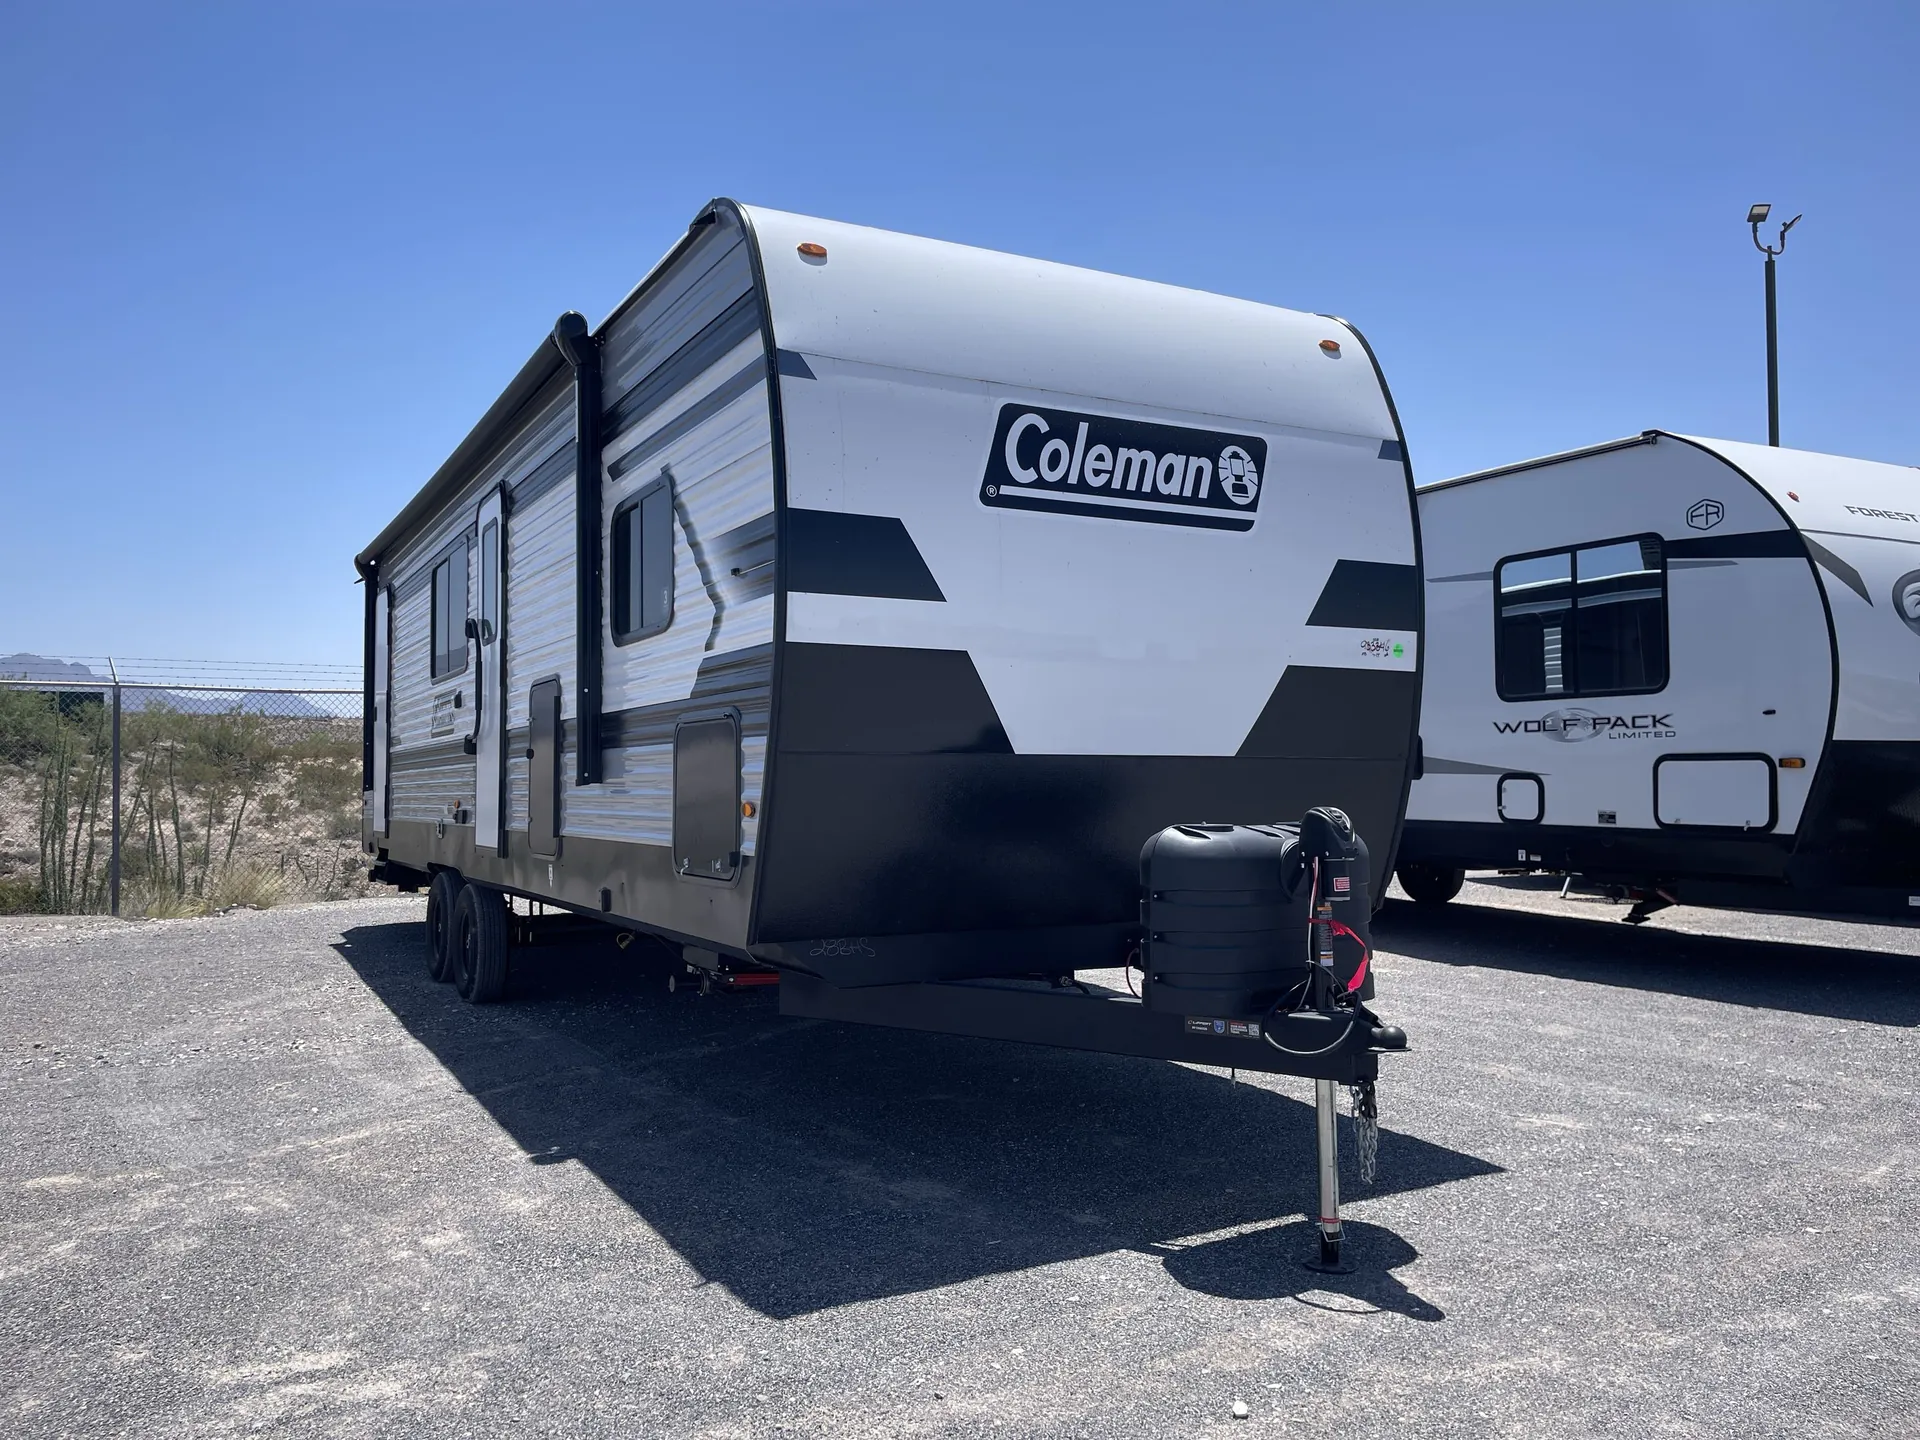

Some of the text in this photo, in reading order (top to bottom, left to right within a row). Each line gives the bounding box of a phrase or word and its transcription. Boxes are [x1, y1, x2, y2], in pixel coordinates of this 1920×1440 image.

[1005, 413, 1213, 499] Coleman
[1844, 505, 1918, 523] FOREST
[1492, 713, 1675, 734] WOLF PACK
[1608, 730, 1677, 739] LIMITED
